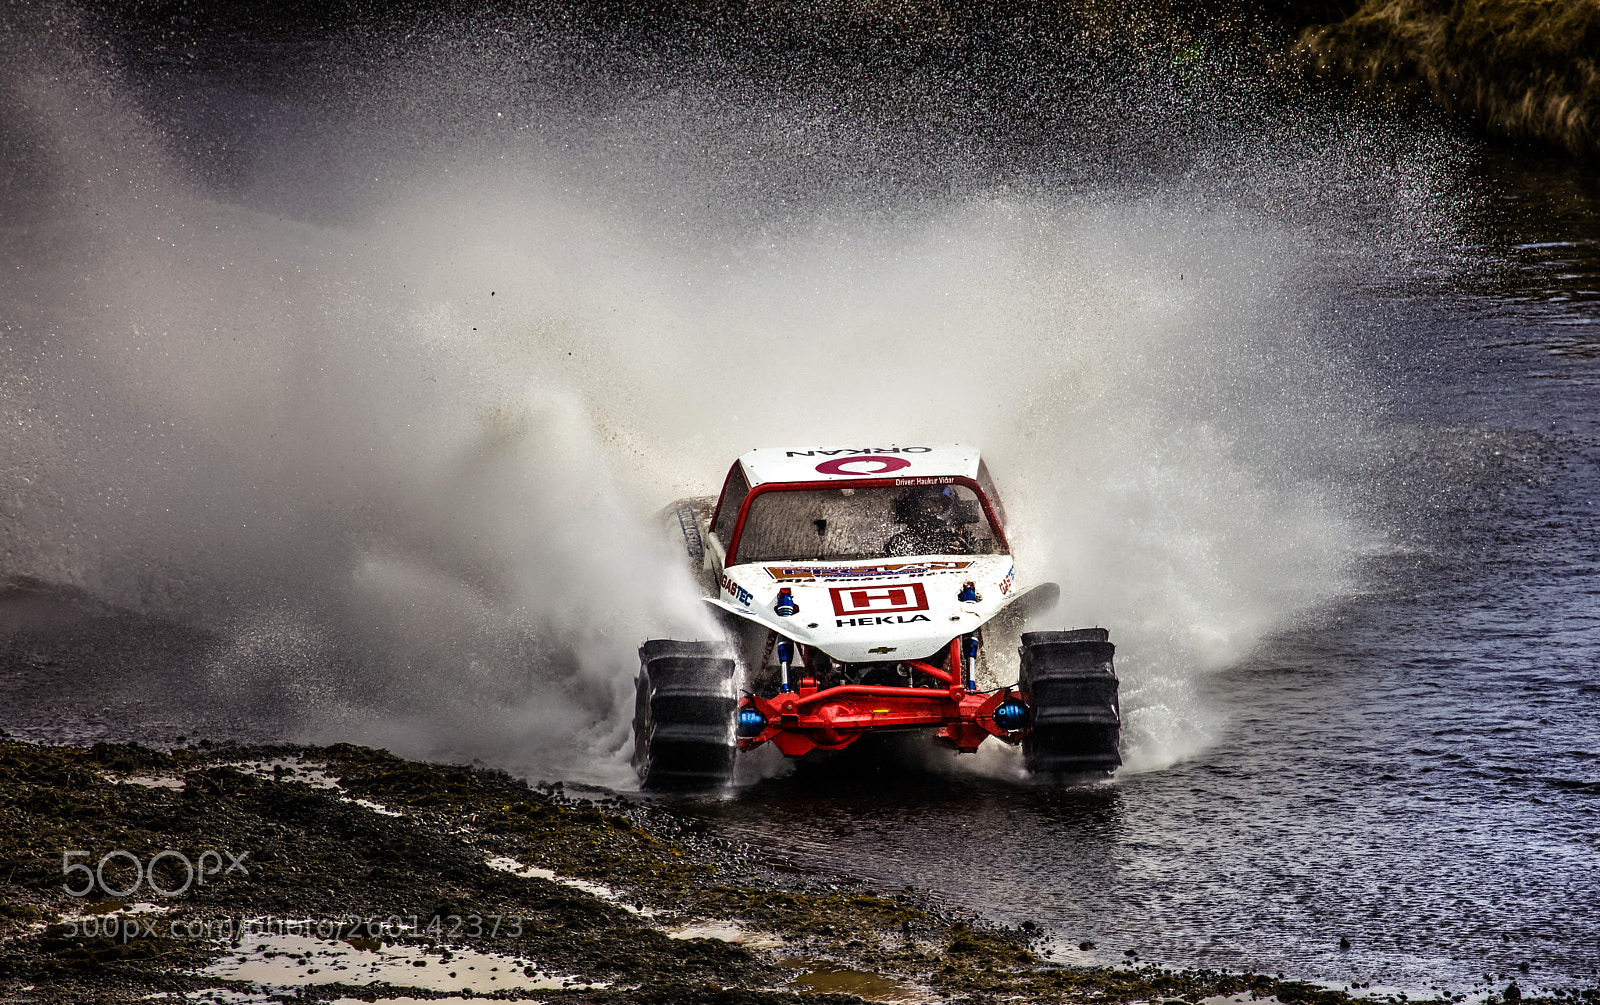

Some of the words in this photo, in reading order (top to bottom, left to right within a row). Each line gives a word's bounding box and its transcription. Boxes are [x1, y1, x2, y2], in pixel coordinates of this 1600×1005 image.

[785, 446, 933, 458] ORKAN
[916, 477, 938, 485] Haukur
[721, 574, 754, 607] GASTEC
[836, 614, 931, 627] HEKLA
